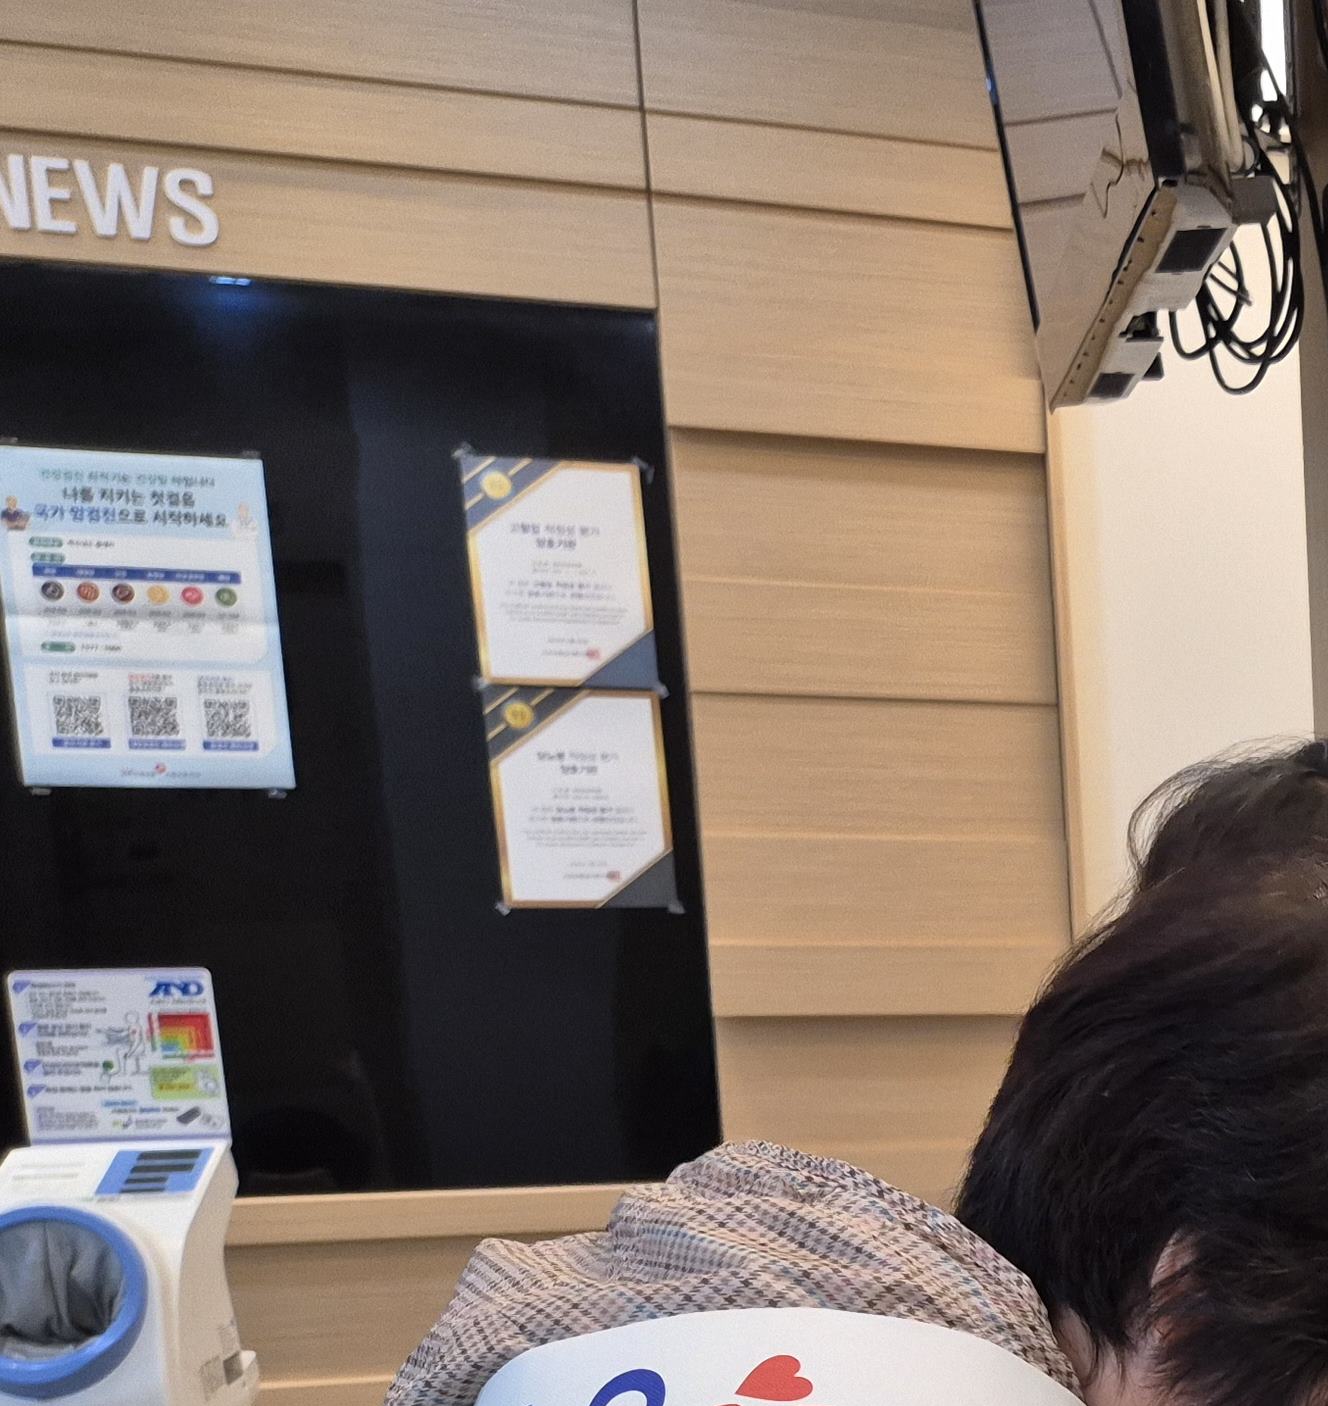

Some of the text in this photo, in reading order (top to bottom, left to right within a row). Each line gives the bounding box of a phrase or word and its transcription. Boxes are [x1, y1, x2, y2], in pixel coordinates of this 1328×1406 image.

[0, 153, 220, 247] NEWS
[62, 486, 196, 508] 나를 지키는 첫걸음
[34, 504, 65, 521] 국가
[152, 508, 228, 528] 시작하세요
